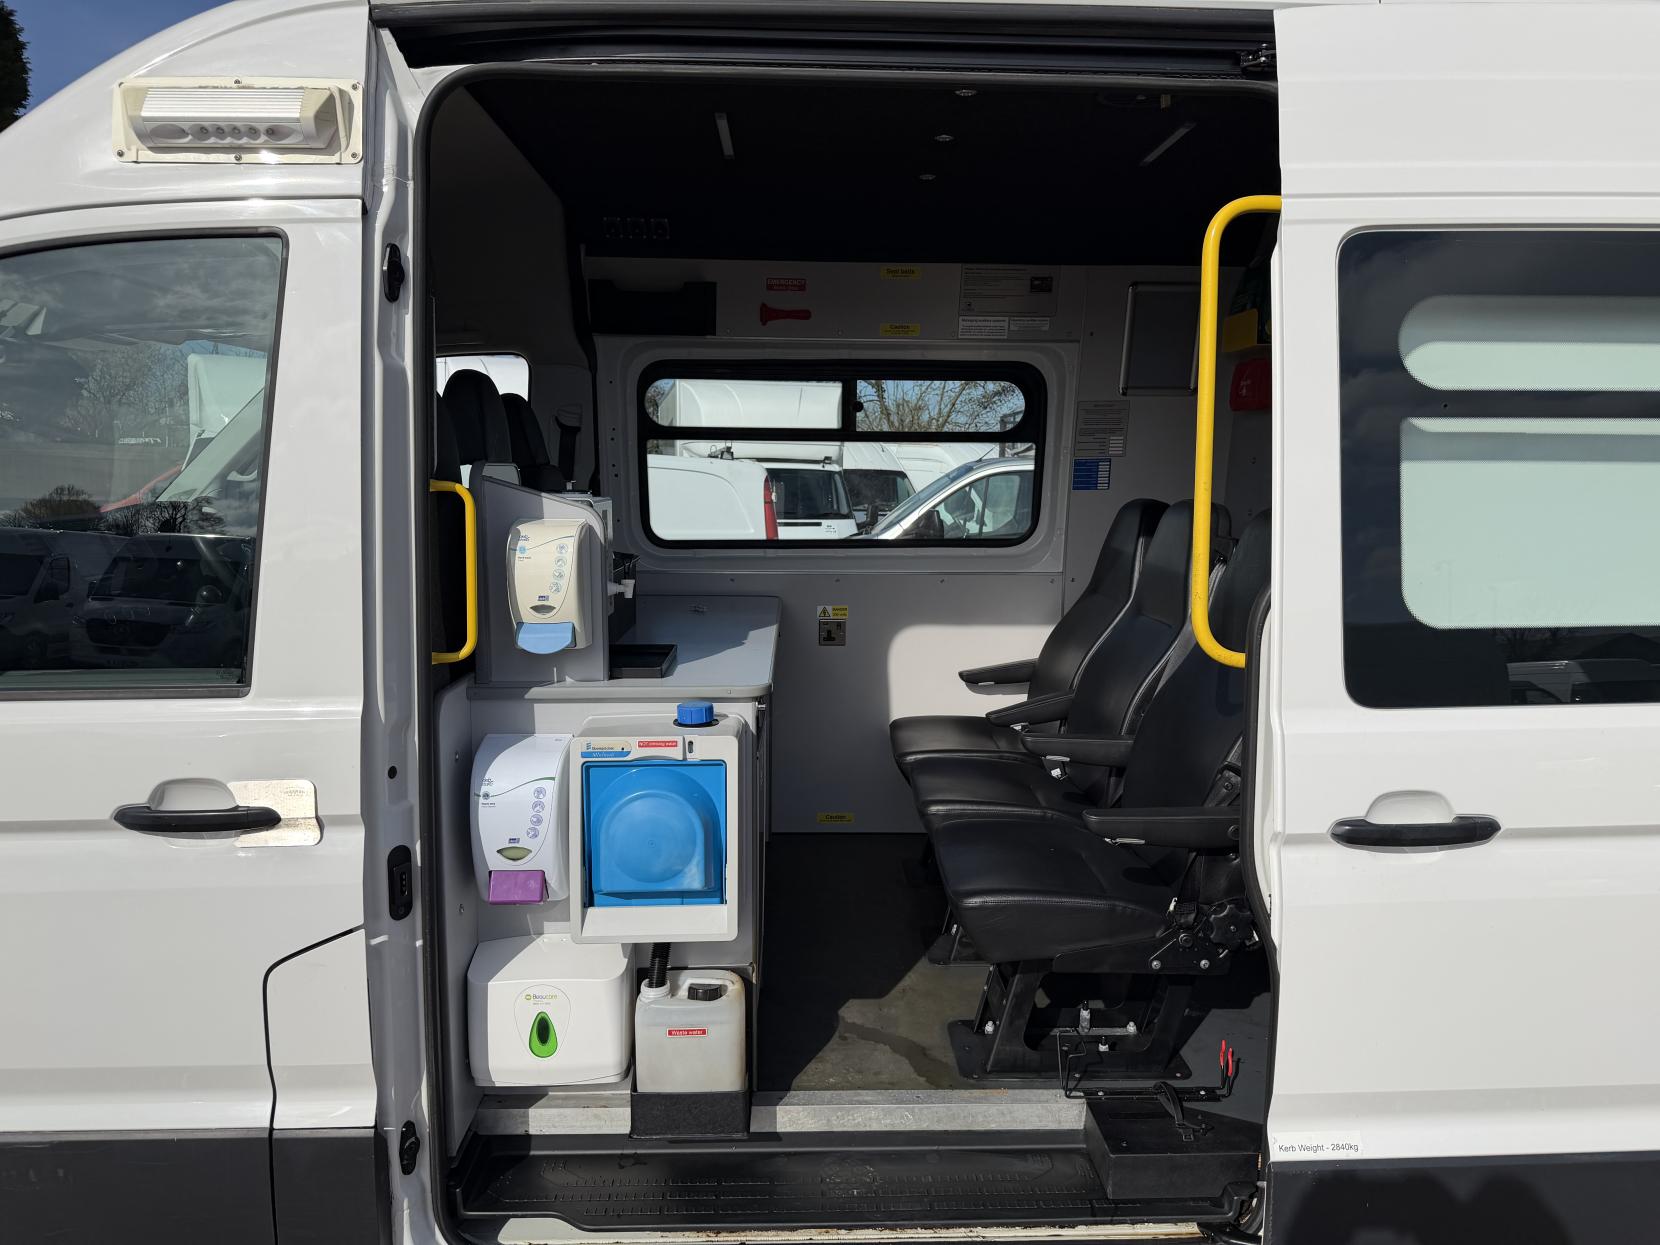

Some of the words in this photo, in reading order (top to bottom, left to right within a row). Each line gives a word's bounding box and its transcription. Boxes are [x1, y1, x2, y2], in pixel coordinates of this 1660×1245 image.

[1278, 1144, 1297, 1152] Kerb
[1298, 1143, 1325, 1153] Weight
[1331, 1143, 1359, 1152] 2840kg
